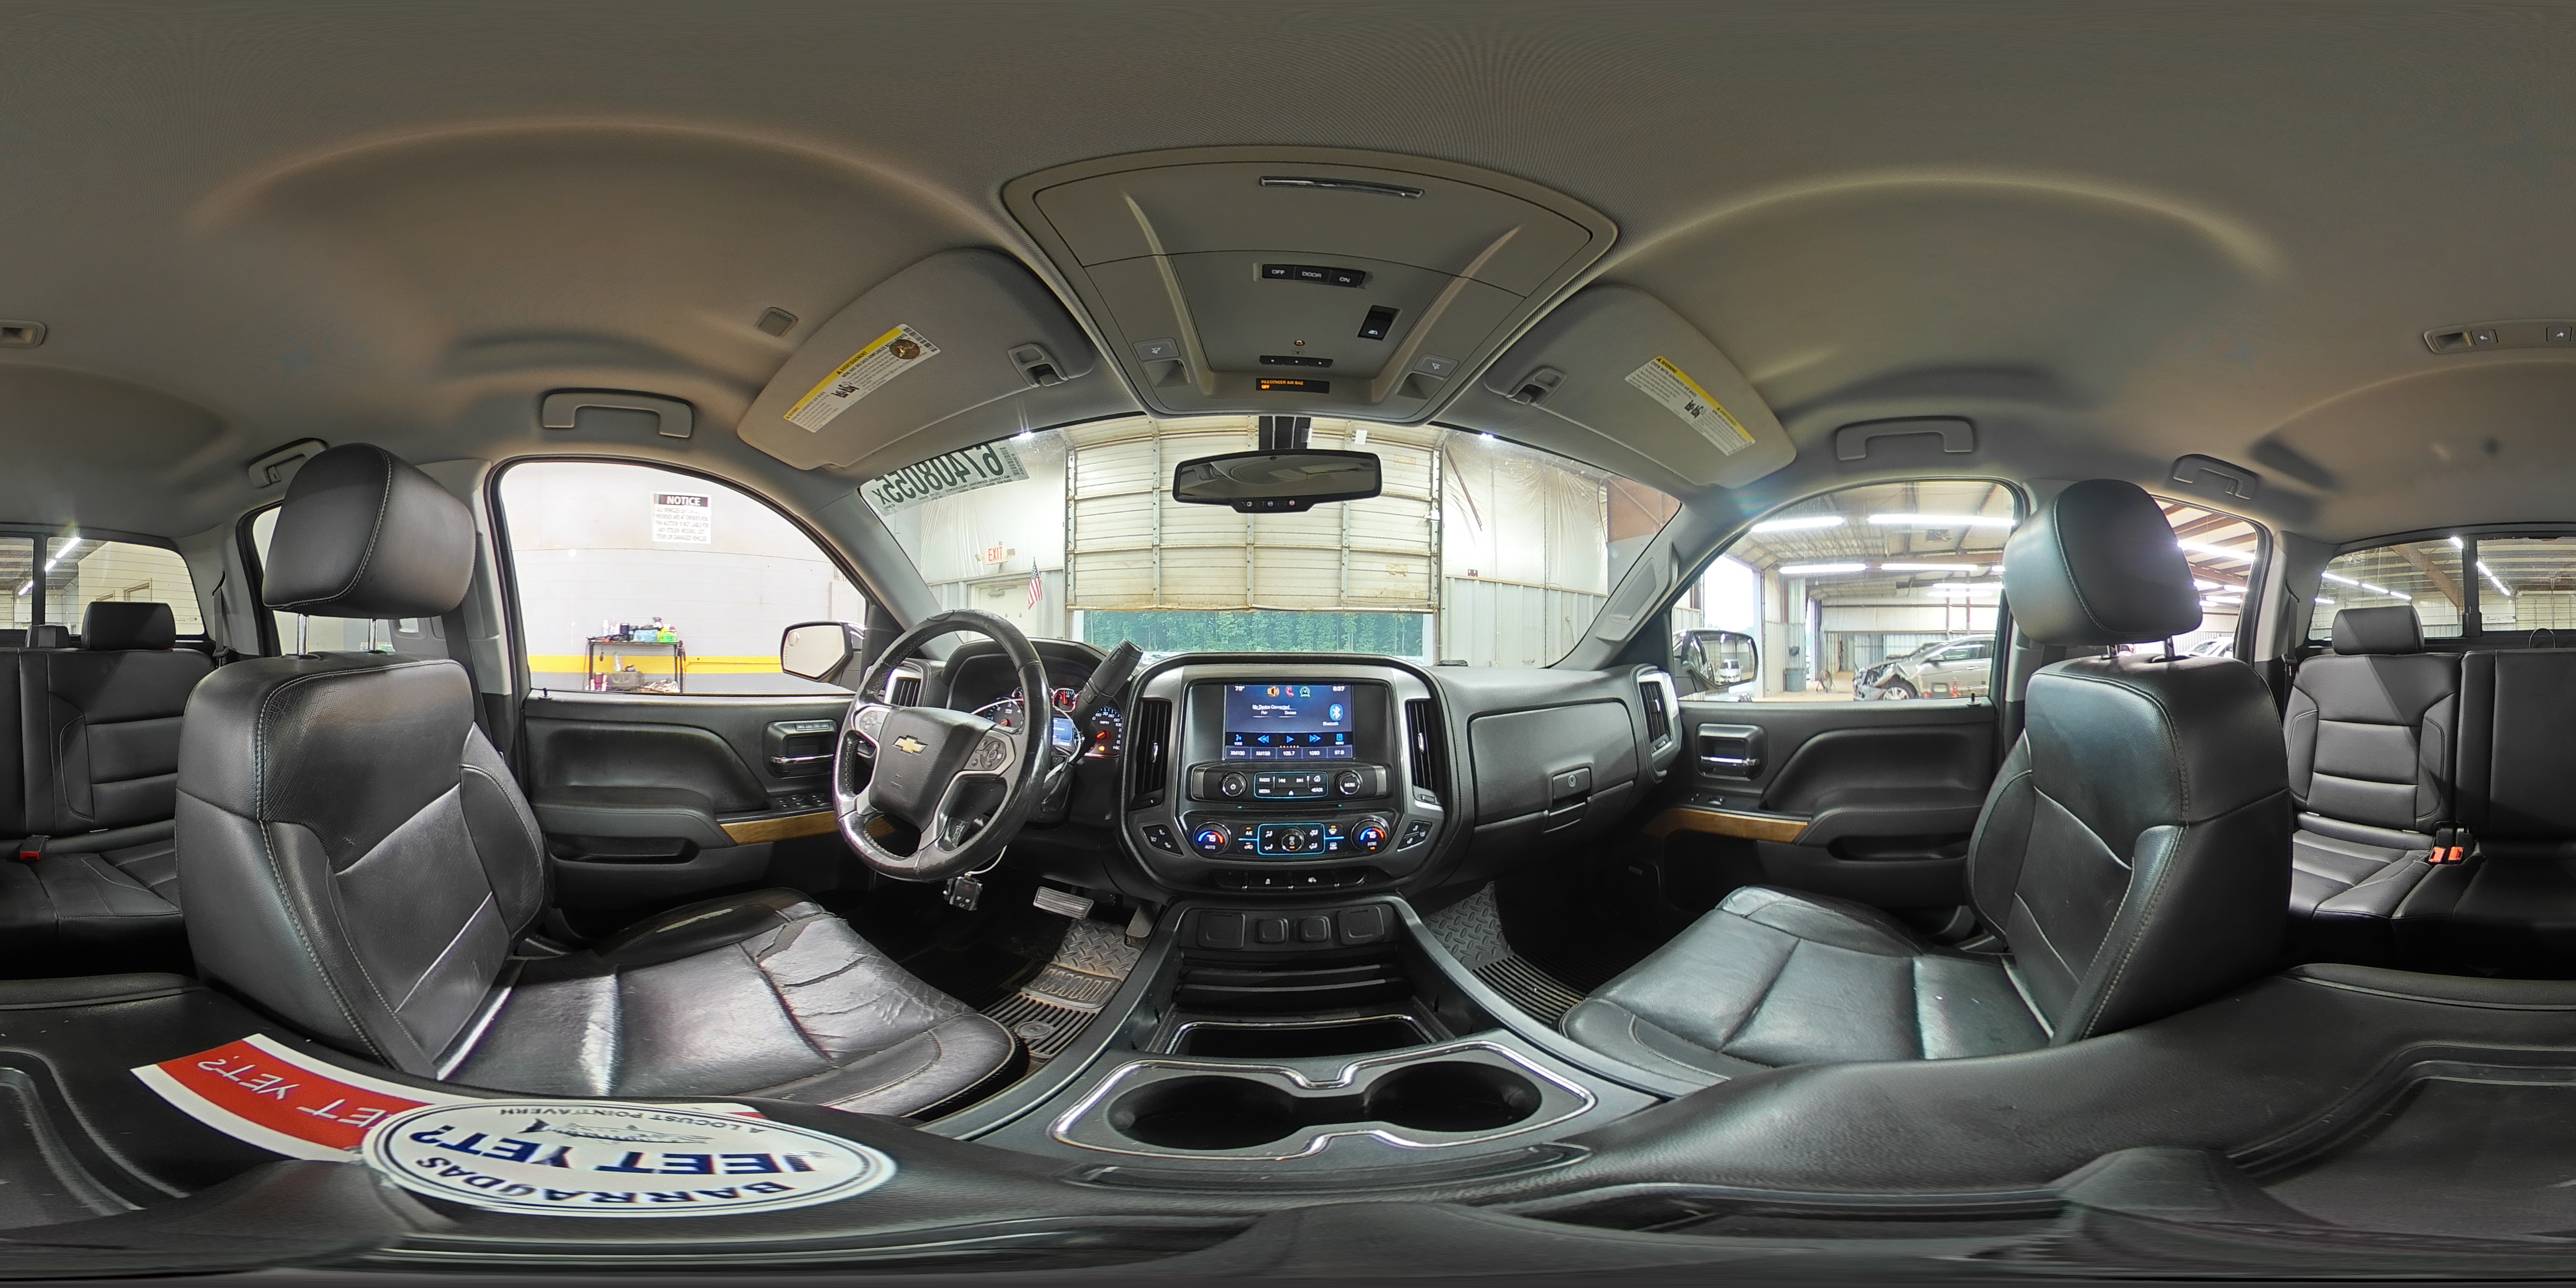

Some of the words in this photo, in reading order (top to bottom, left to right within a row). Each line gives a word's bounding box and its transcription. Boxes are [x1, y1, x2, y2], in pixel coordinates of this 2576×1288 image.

[667, 495, 701, 506] NOTICE
[988, 546, 1003, 562] EXIT
[197, 1056, 301, 1100] YET?
[648, 1114, 744, 1131] LOCUST
[408, 1125, 574, 1169] YET?
